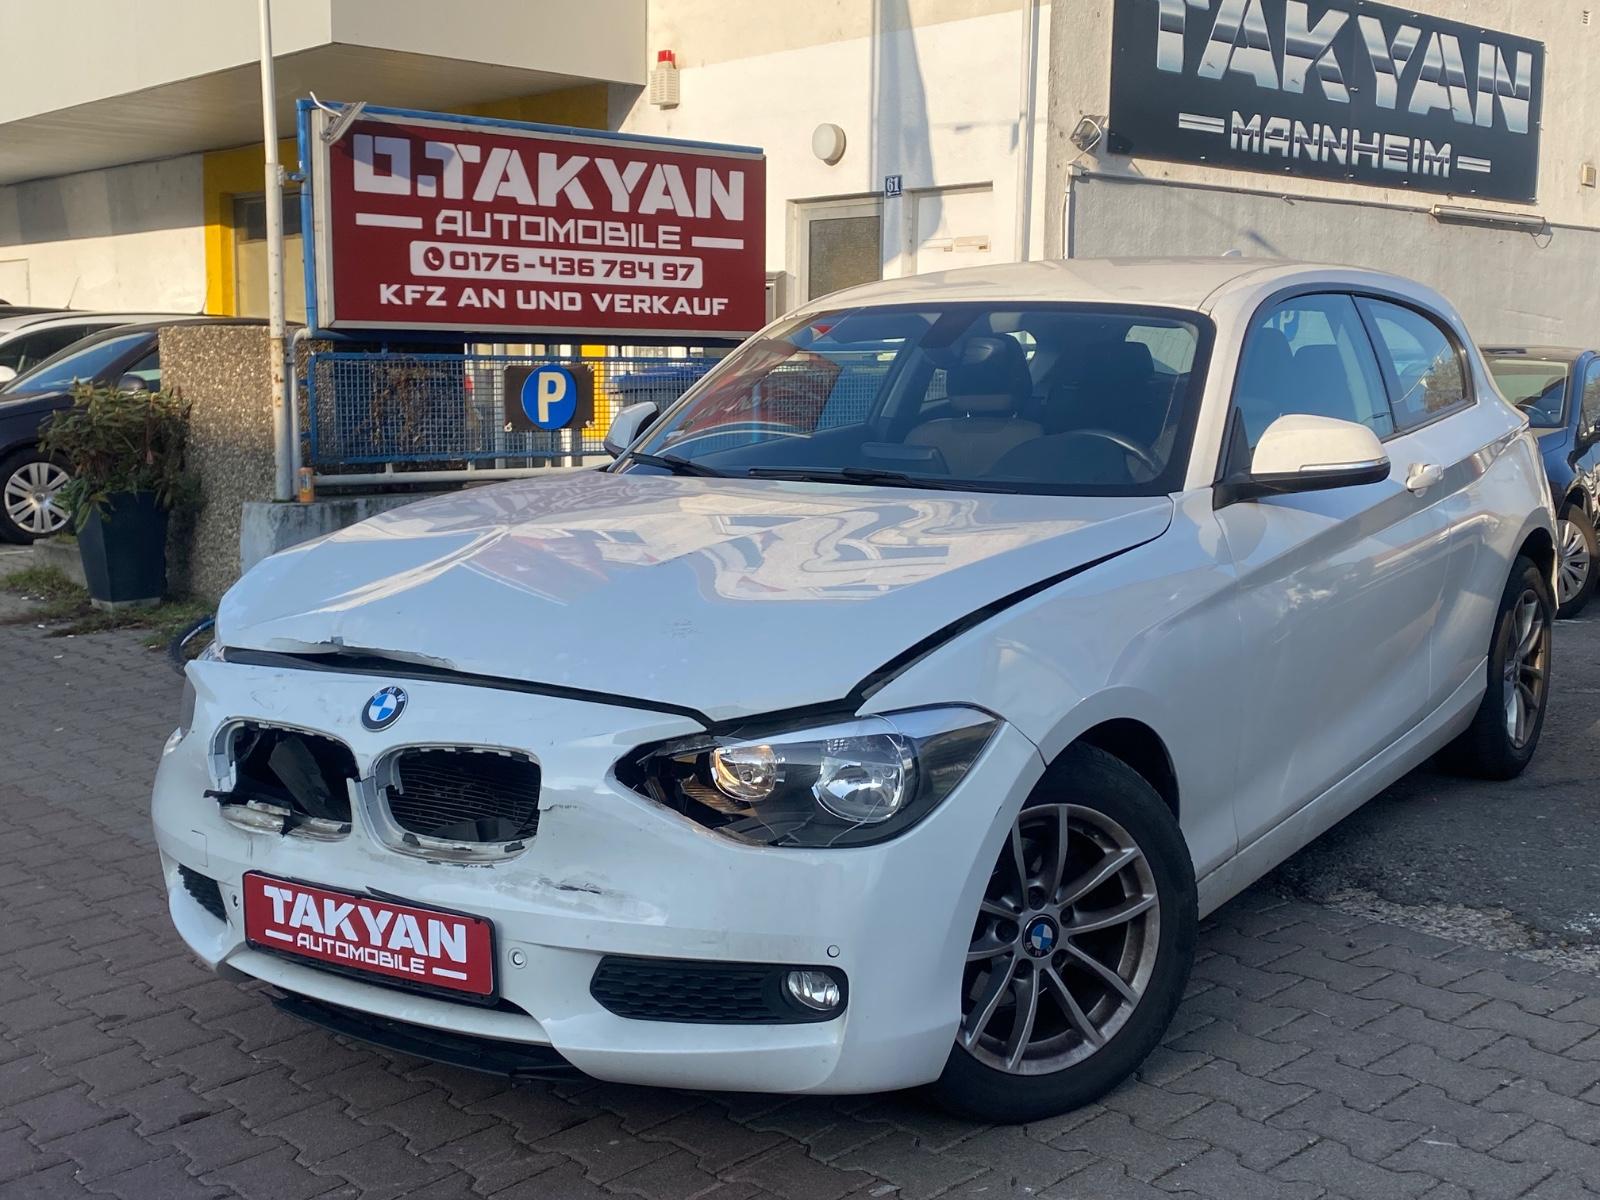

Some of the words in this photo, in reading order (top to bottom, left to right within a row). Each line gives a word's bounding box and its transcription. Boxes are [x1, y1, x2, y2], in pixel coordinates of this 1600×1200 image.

[1157, 0, 1532, 134] TAKYAN
[1230, 111, 1452, 177] MANNHEIM
[353, 134, 744, 220] O.TAKYAN
[887, 177, 900, 192] 61
[436, 210, 682, 249] AUTOMOBILE
[380, 284, 447, 306] KFZ
[457, 288, 505, 309] AN
[517, 290, 582, 311] UND
[592, 293, 728, 316] VERKAUF
[537, 371, 567, 423] P
[263, 885, 466, 963] TAKYAN
[297, 933, 425, 975] AUTOMOBILE
